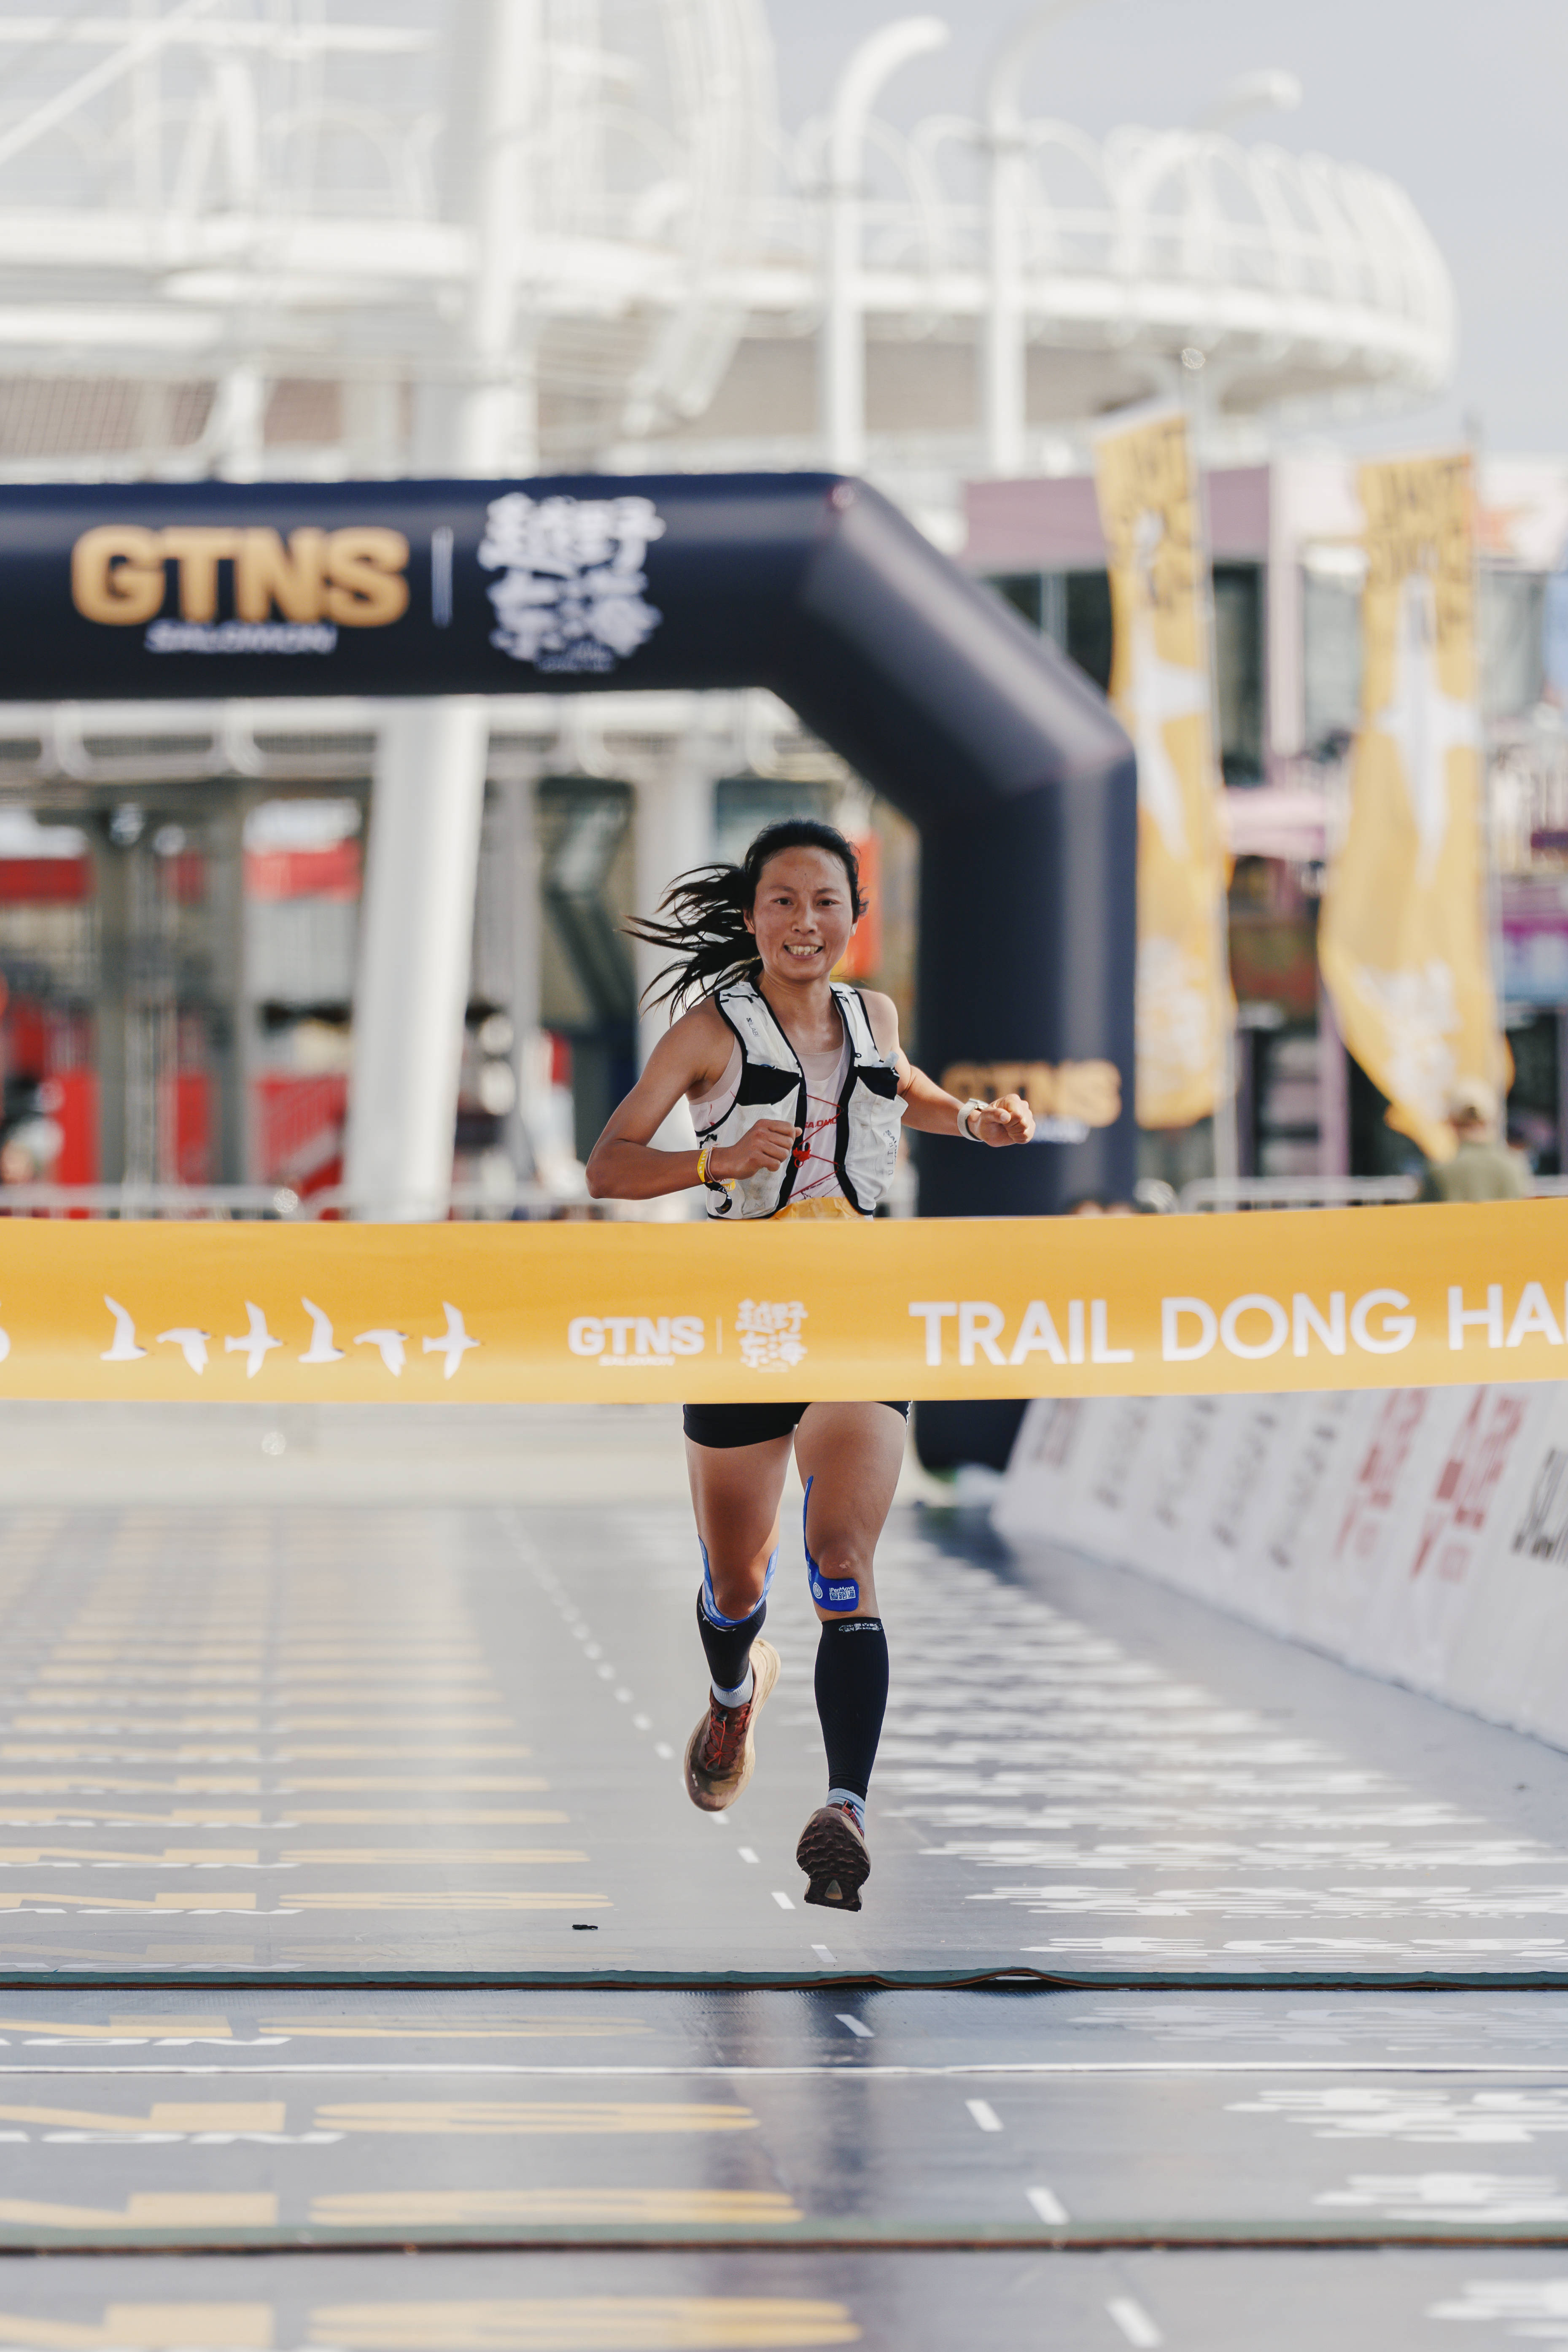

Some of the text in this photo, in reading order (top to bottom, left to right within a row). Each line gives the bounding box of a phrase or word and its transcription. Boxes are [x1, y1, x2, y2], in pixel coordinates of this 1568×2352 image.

[72, 524, 410, 627] GTNS
[568, 1316, 705, 1355] GTNS
[908, 1281, 1568, 1366] TRAIL DONG HA
[598, 1354, 676, 1366] SALOMON
